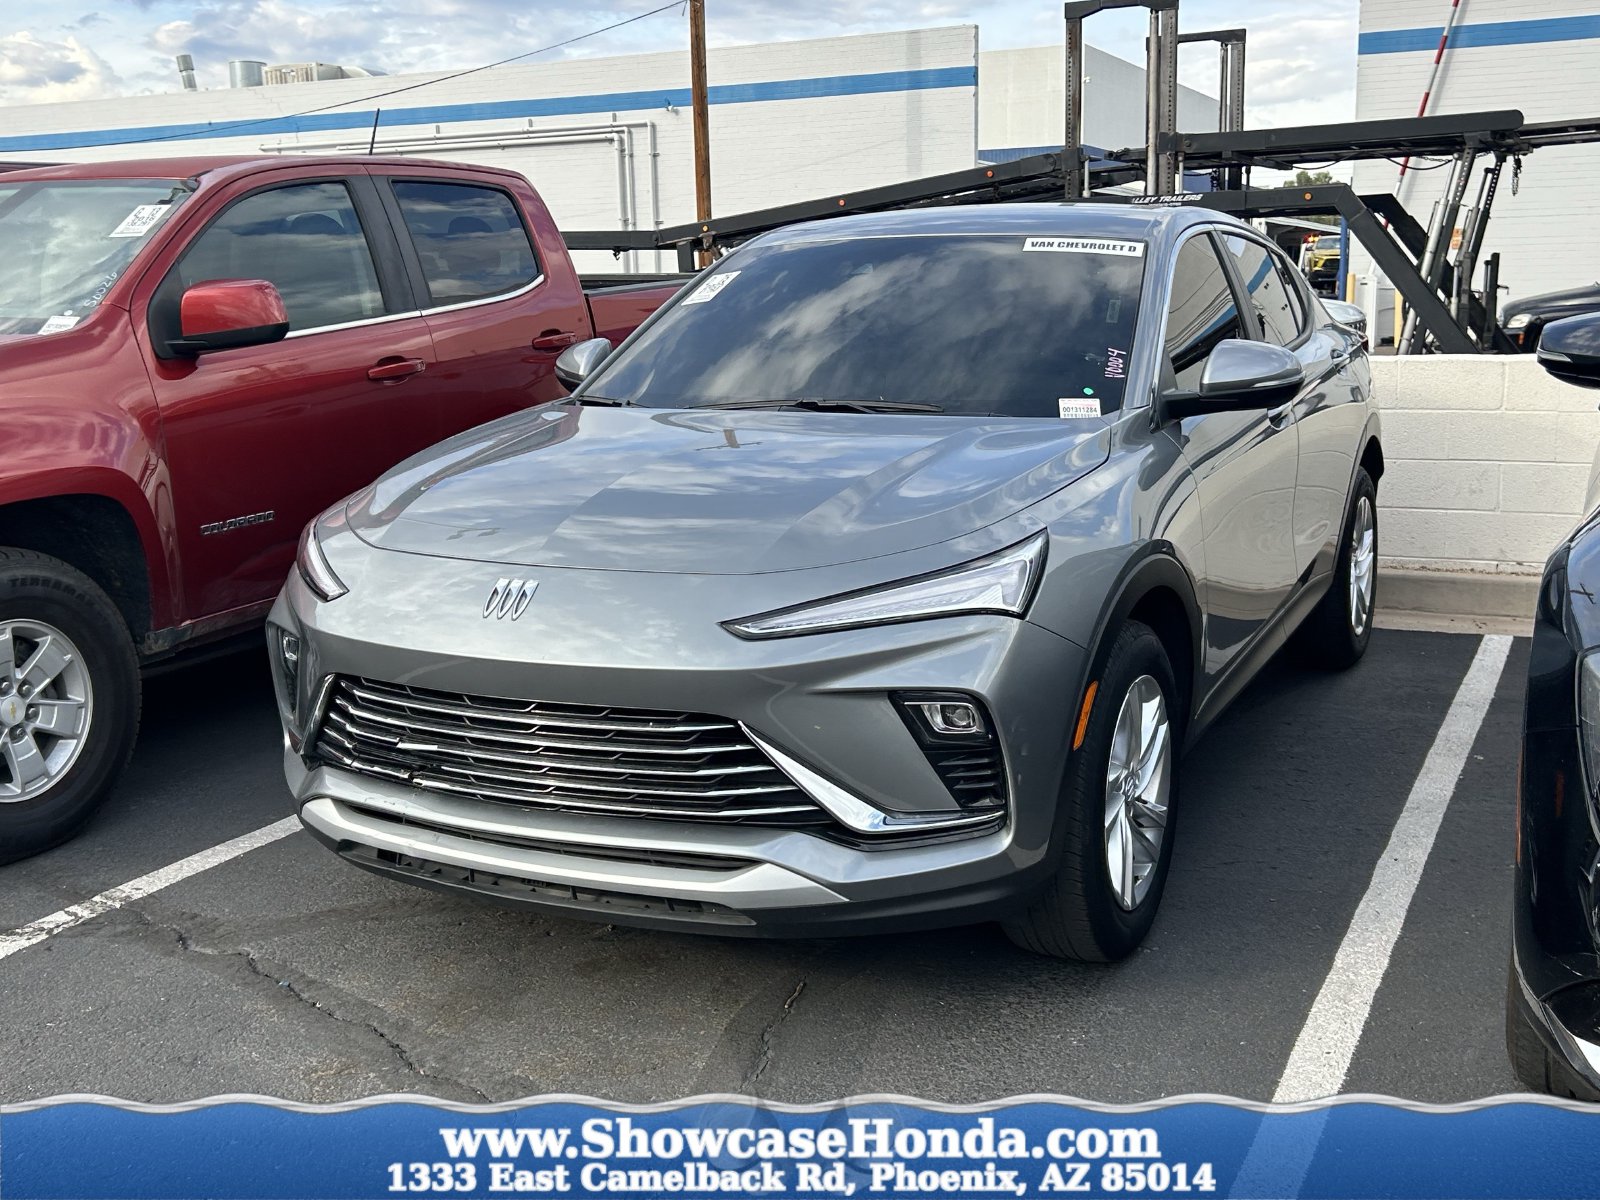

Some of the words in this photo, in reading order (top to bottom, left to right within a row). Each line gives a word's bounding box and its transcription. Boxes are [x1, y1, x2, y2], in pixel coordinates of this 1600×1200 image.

[1159, 194, 1203, 202] TRAILERS
[1057, 241, 1126, 252] CHEVROLET
[200, 510, 275, 535] COLORADO
